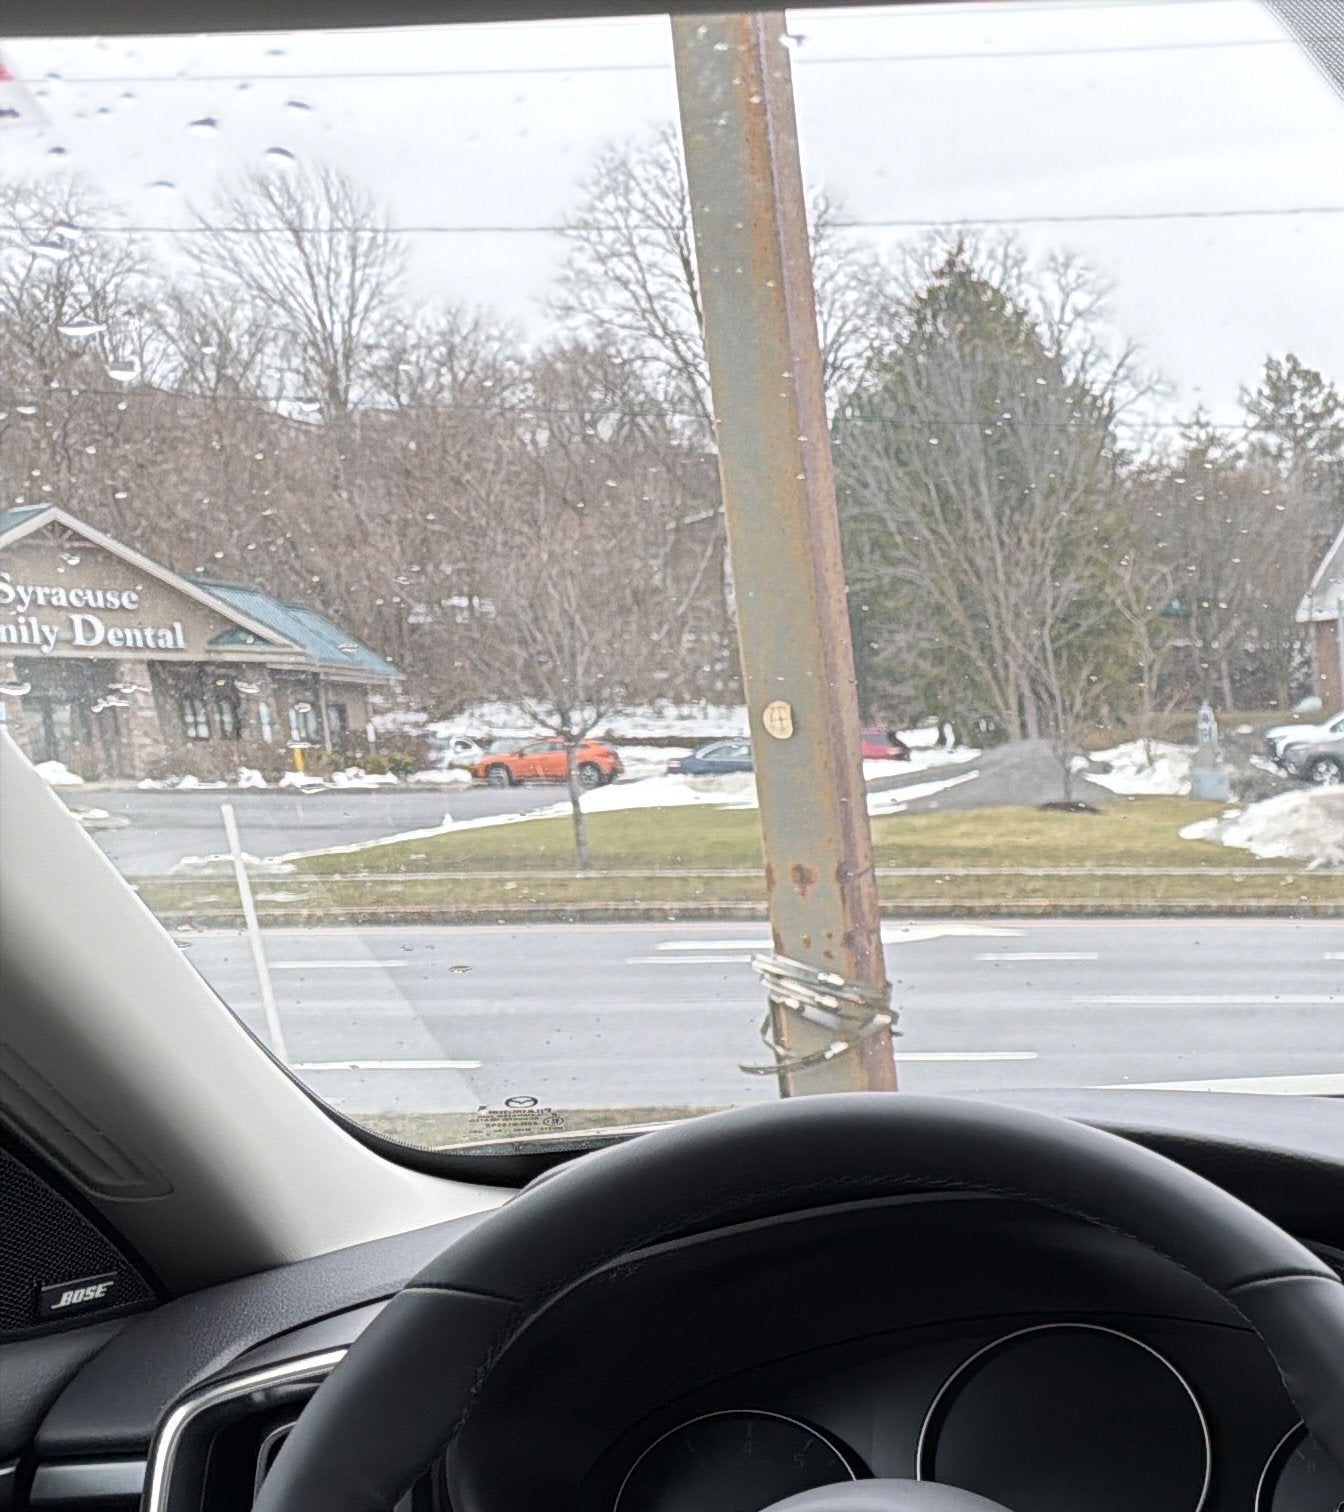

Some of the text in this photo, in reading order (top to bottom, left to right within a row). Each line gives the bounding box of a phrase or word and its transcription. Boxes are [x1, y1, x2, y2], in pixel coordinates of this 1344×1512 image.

[0, 572, 140, 613] Syracuse
[69, 613, 187, 650] Dental
[50, 1281, 115, 1310] BOSE
